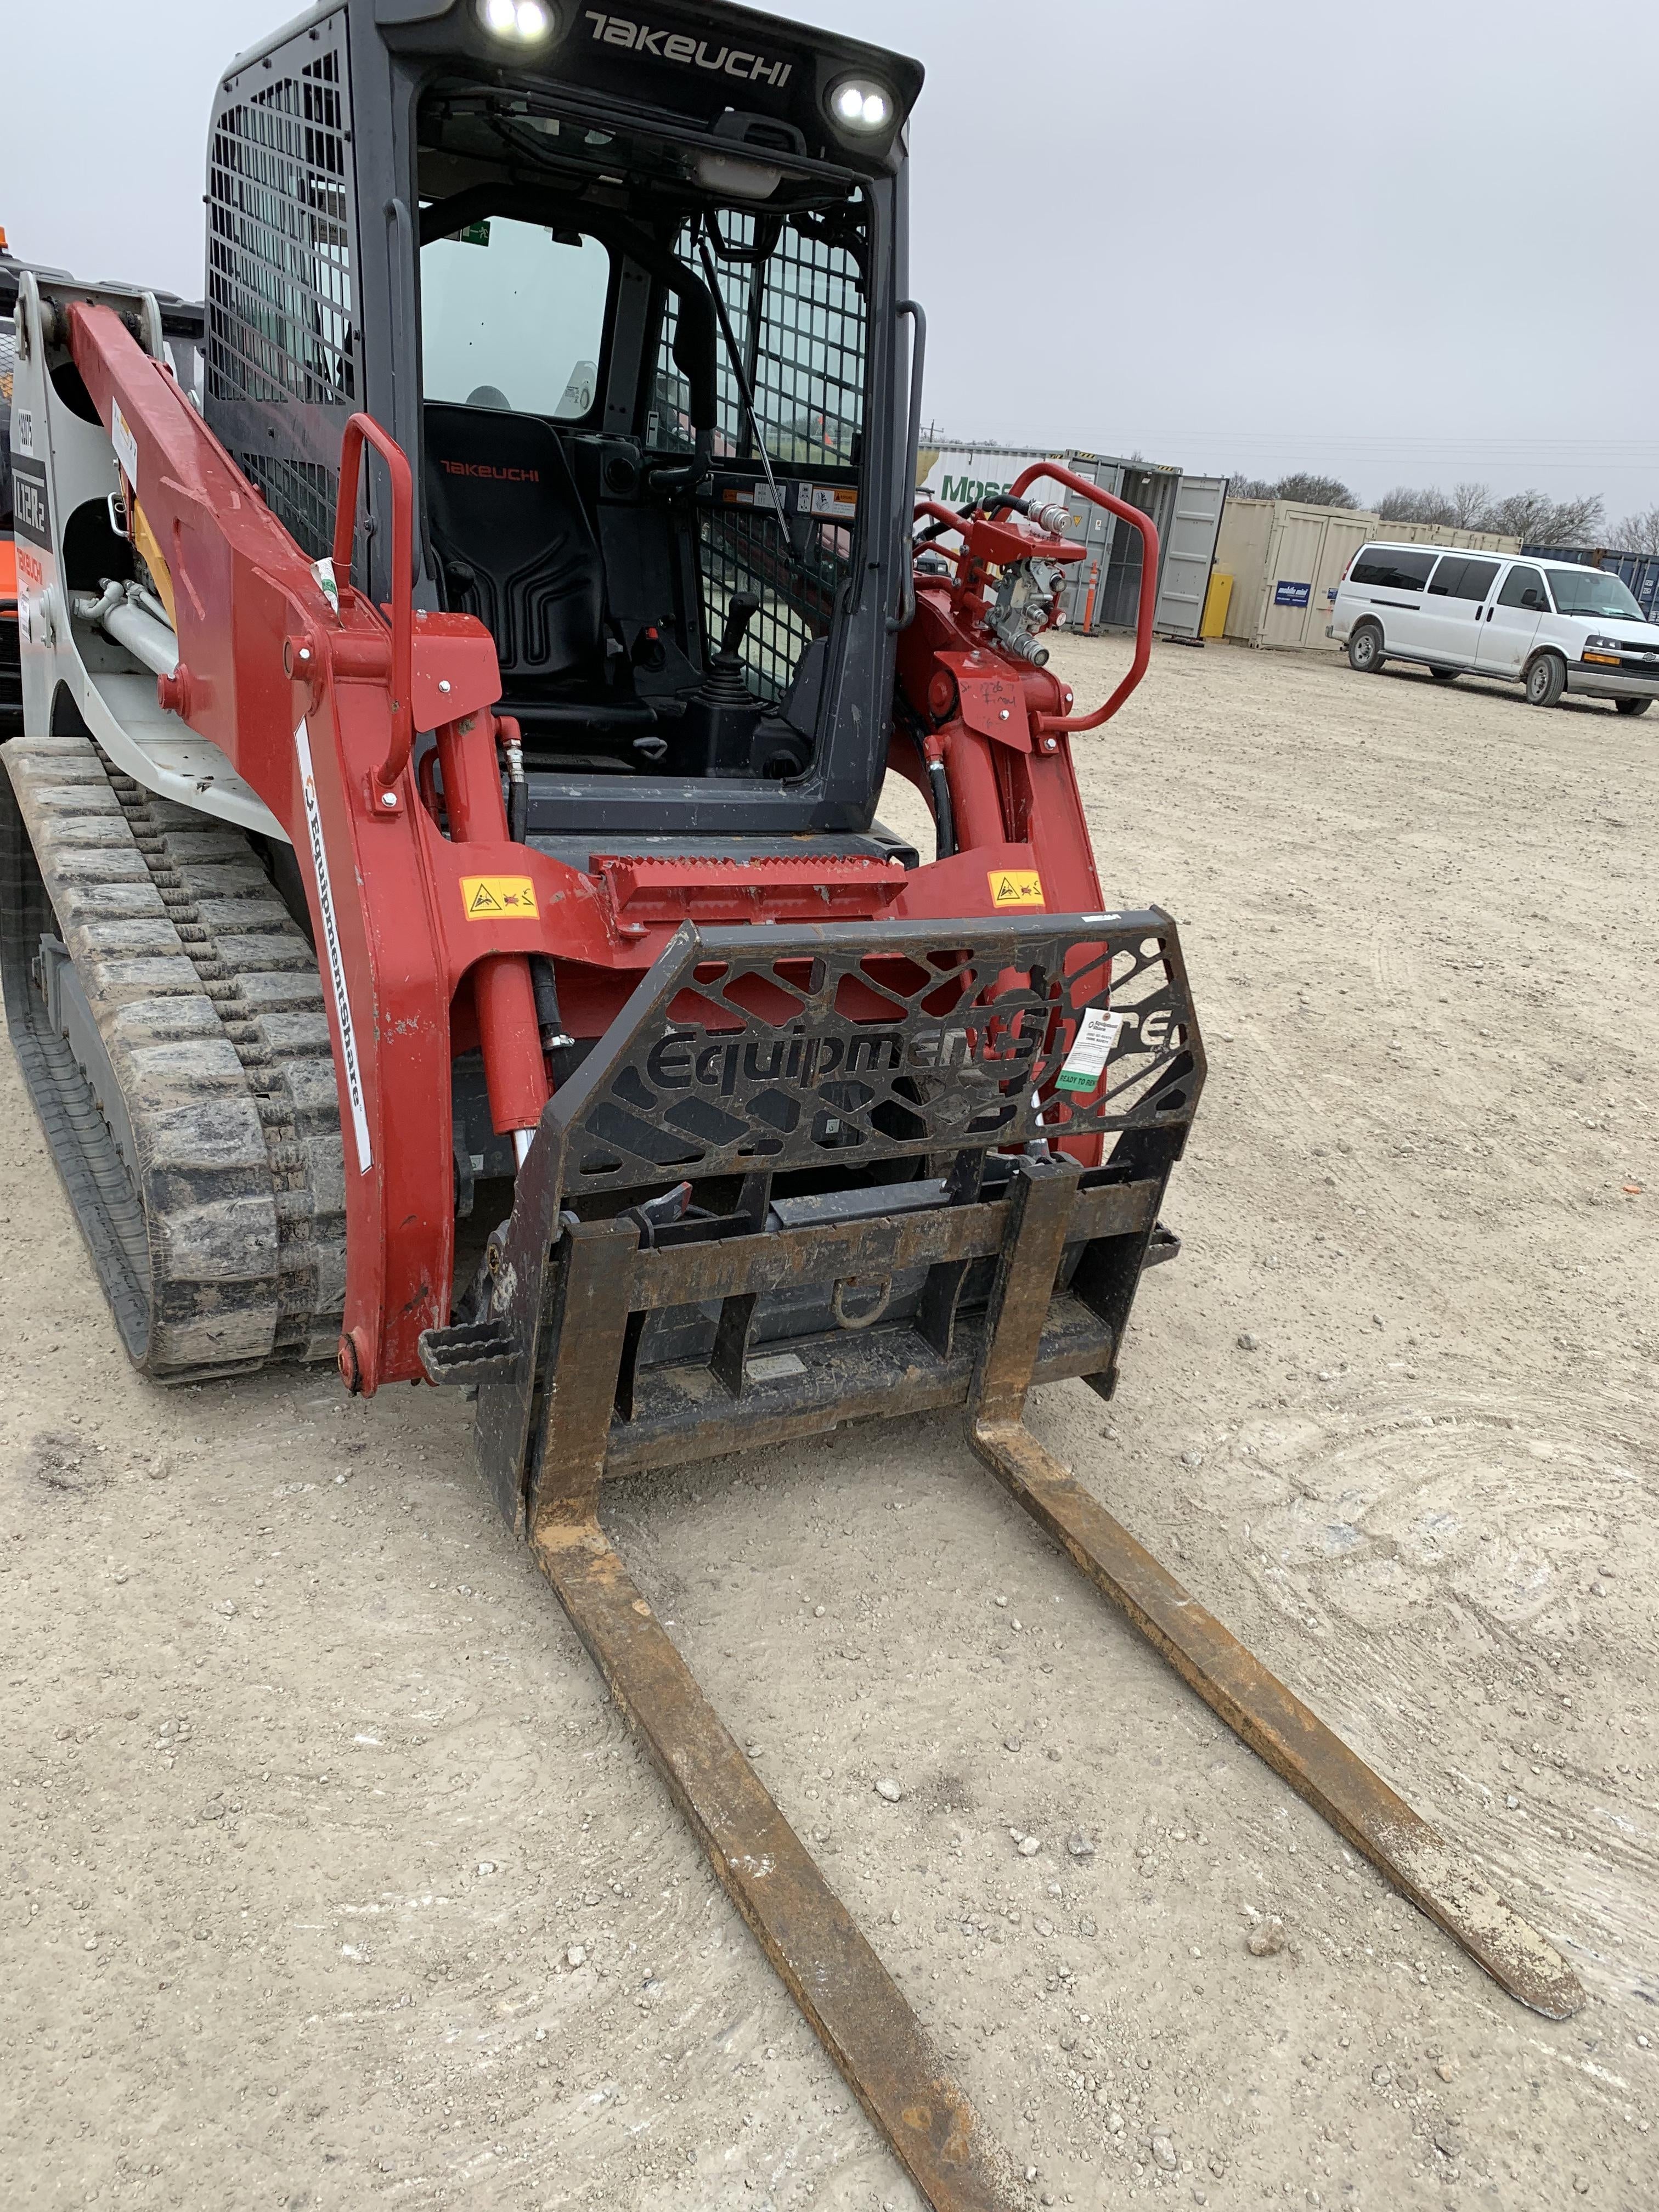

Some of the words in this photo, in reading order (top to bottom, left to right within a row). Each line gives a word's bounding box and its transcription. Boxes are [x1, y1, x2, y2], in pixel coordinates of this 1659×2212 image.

[311, 815, 360, 1108] EquipmentShare
[647, 1007, 1172, 1097] EquipmentShre
[1059, 1075, 1077, 1084] READY
